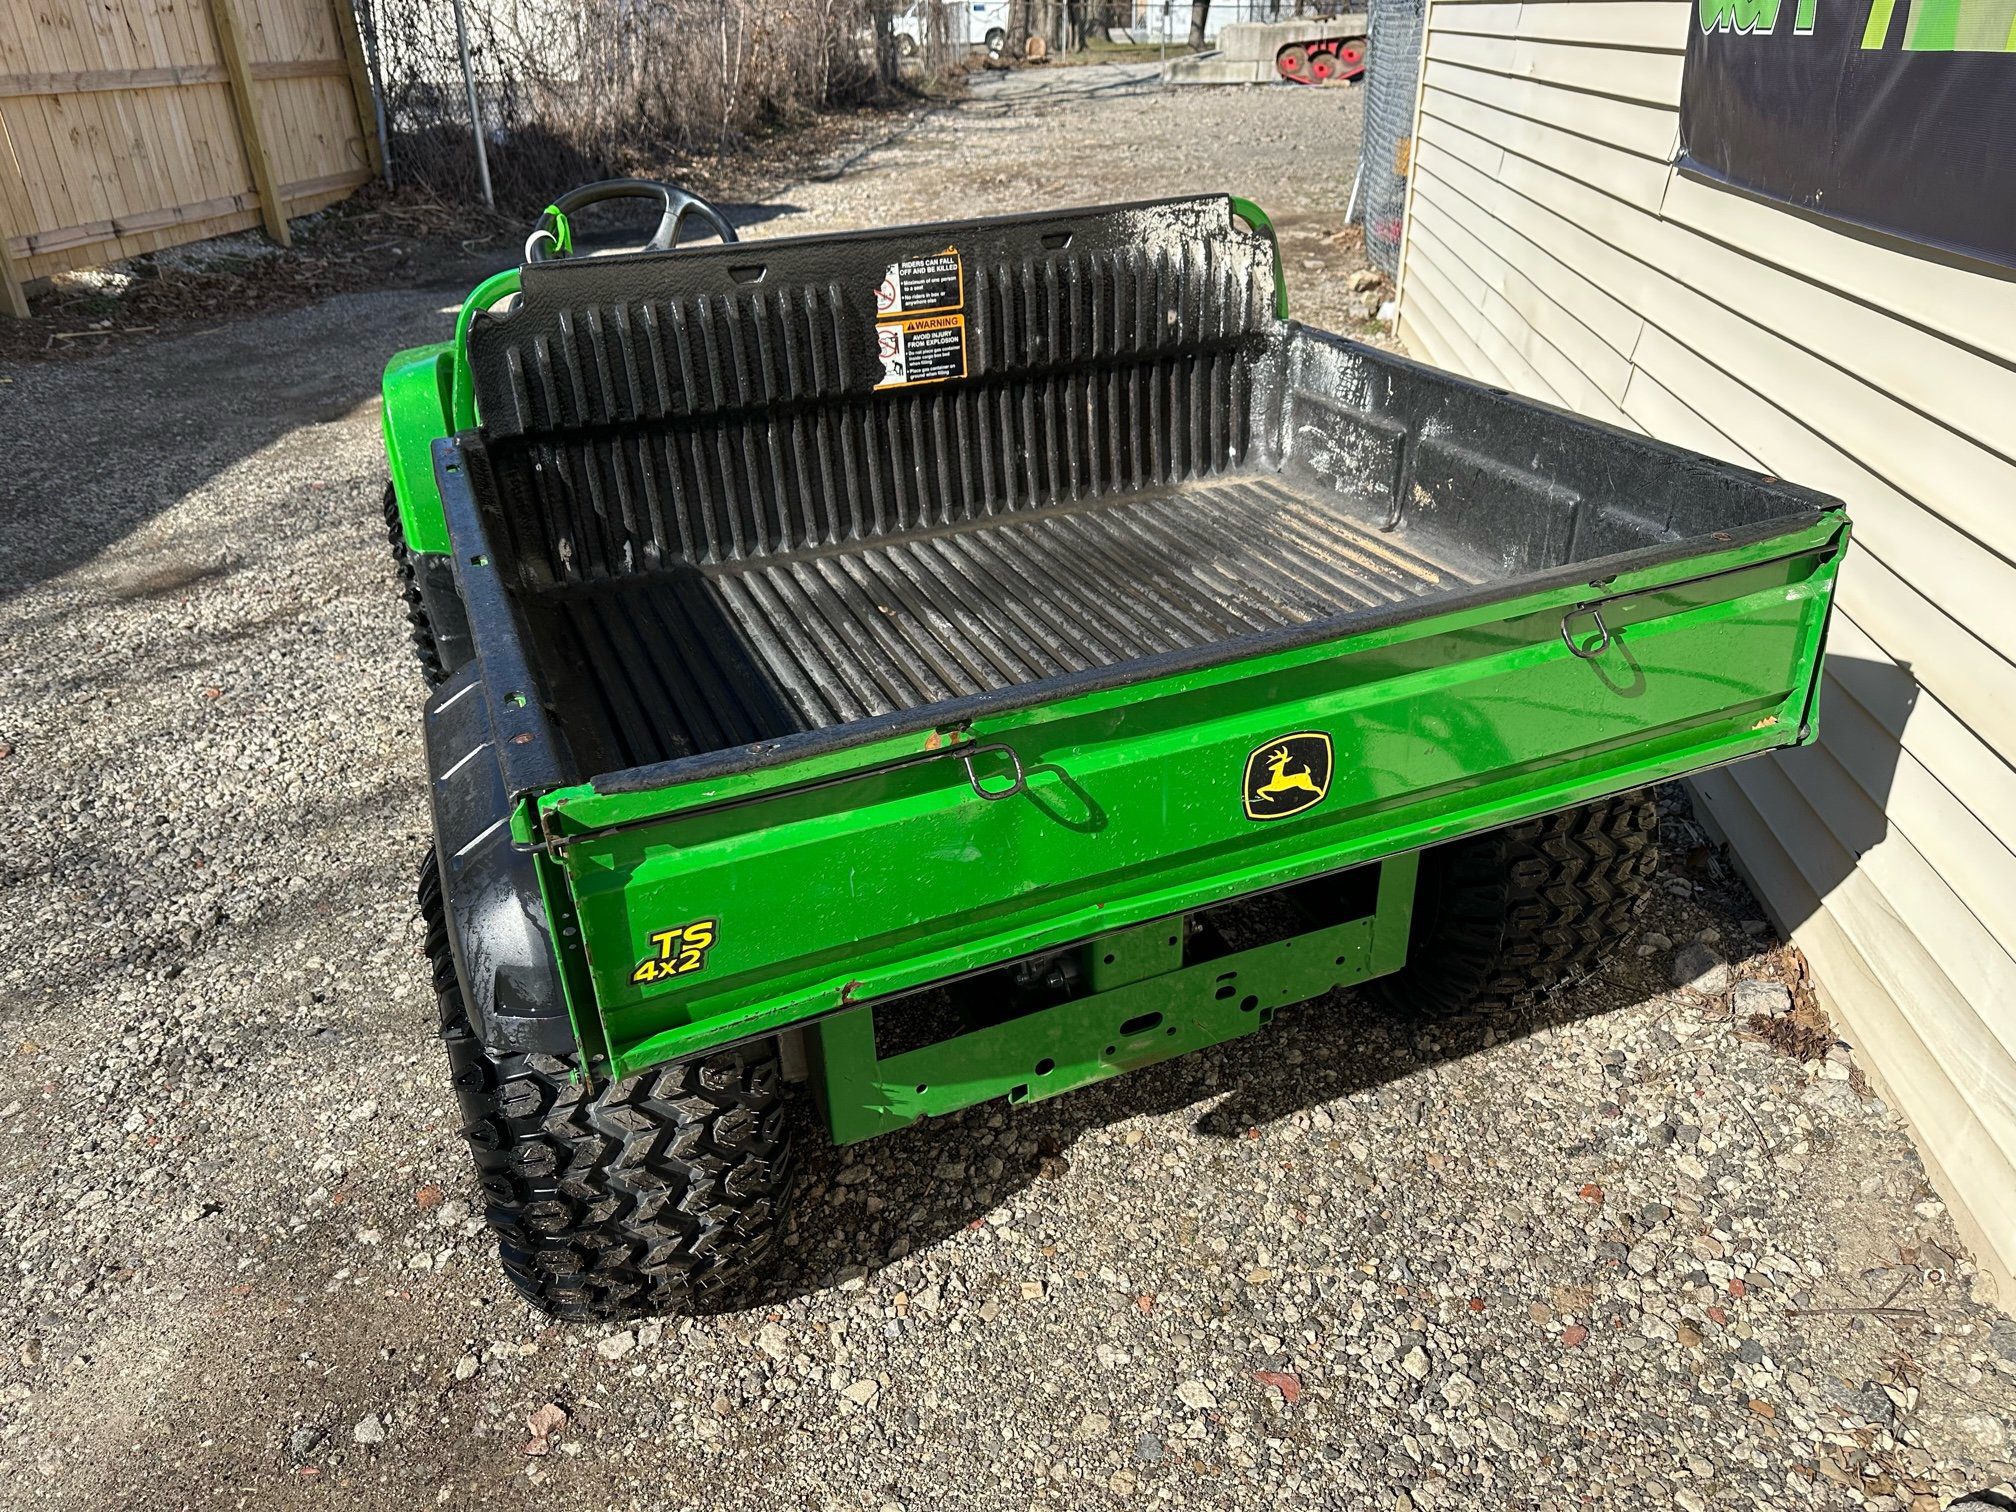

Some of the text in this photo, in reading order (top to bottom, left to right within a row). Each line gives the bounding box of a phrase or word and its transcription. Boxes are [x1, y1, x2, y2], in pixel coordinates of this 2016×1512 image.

[915, 317, 957, 330] WARNING
[926, 337, 958, 346] EXPLOSION
[652, 921, 713, 960] TS
[633, 949, 701, 982] 4x2
